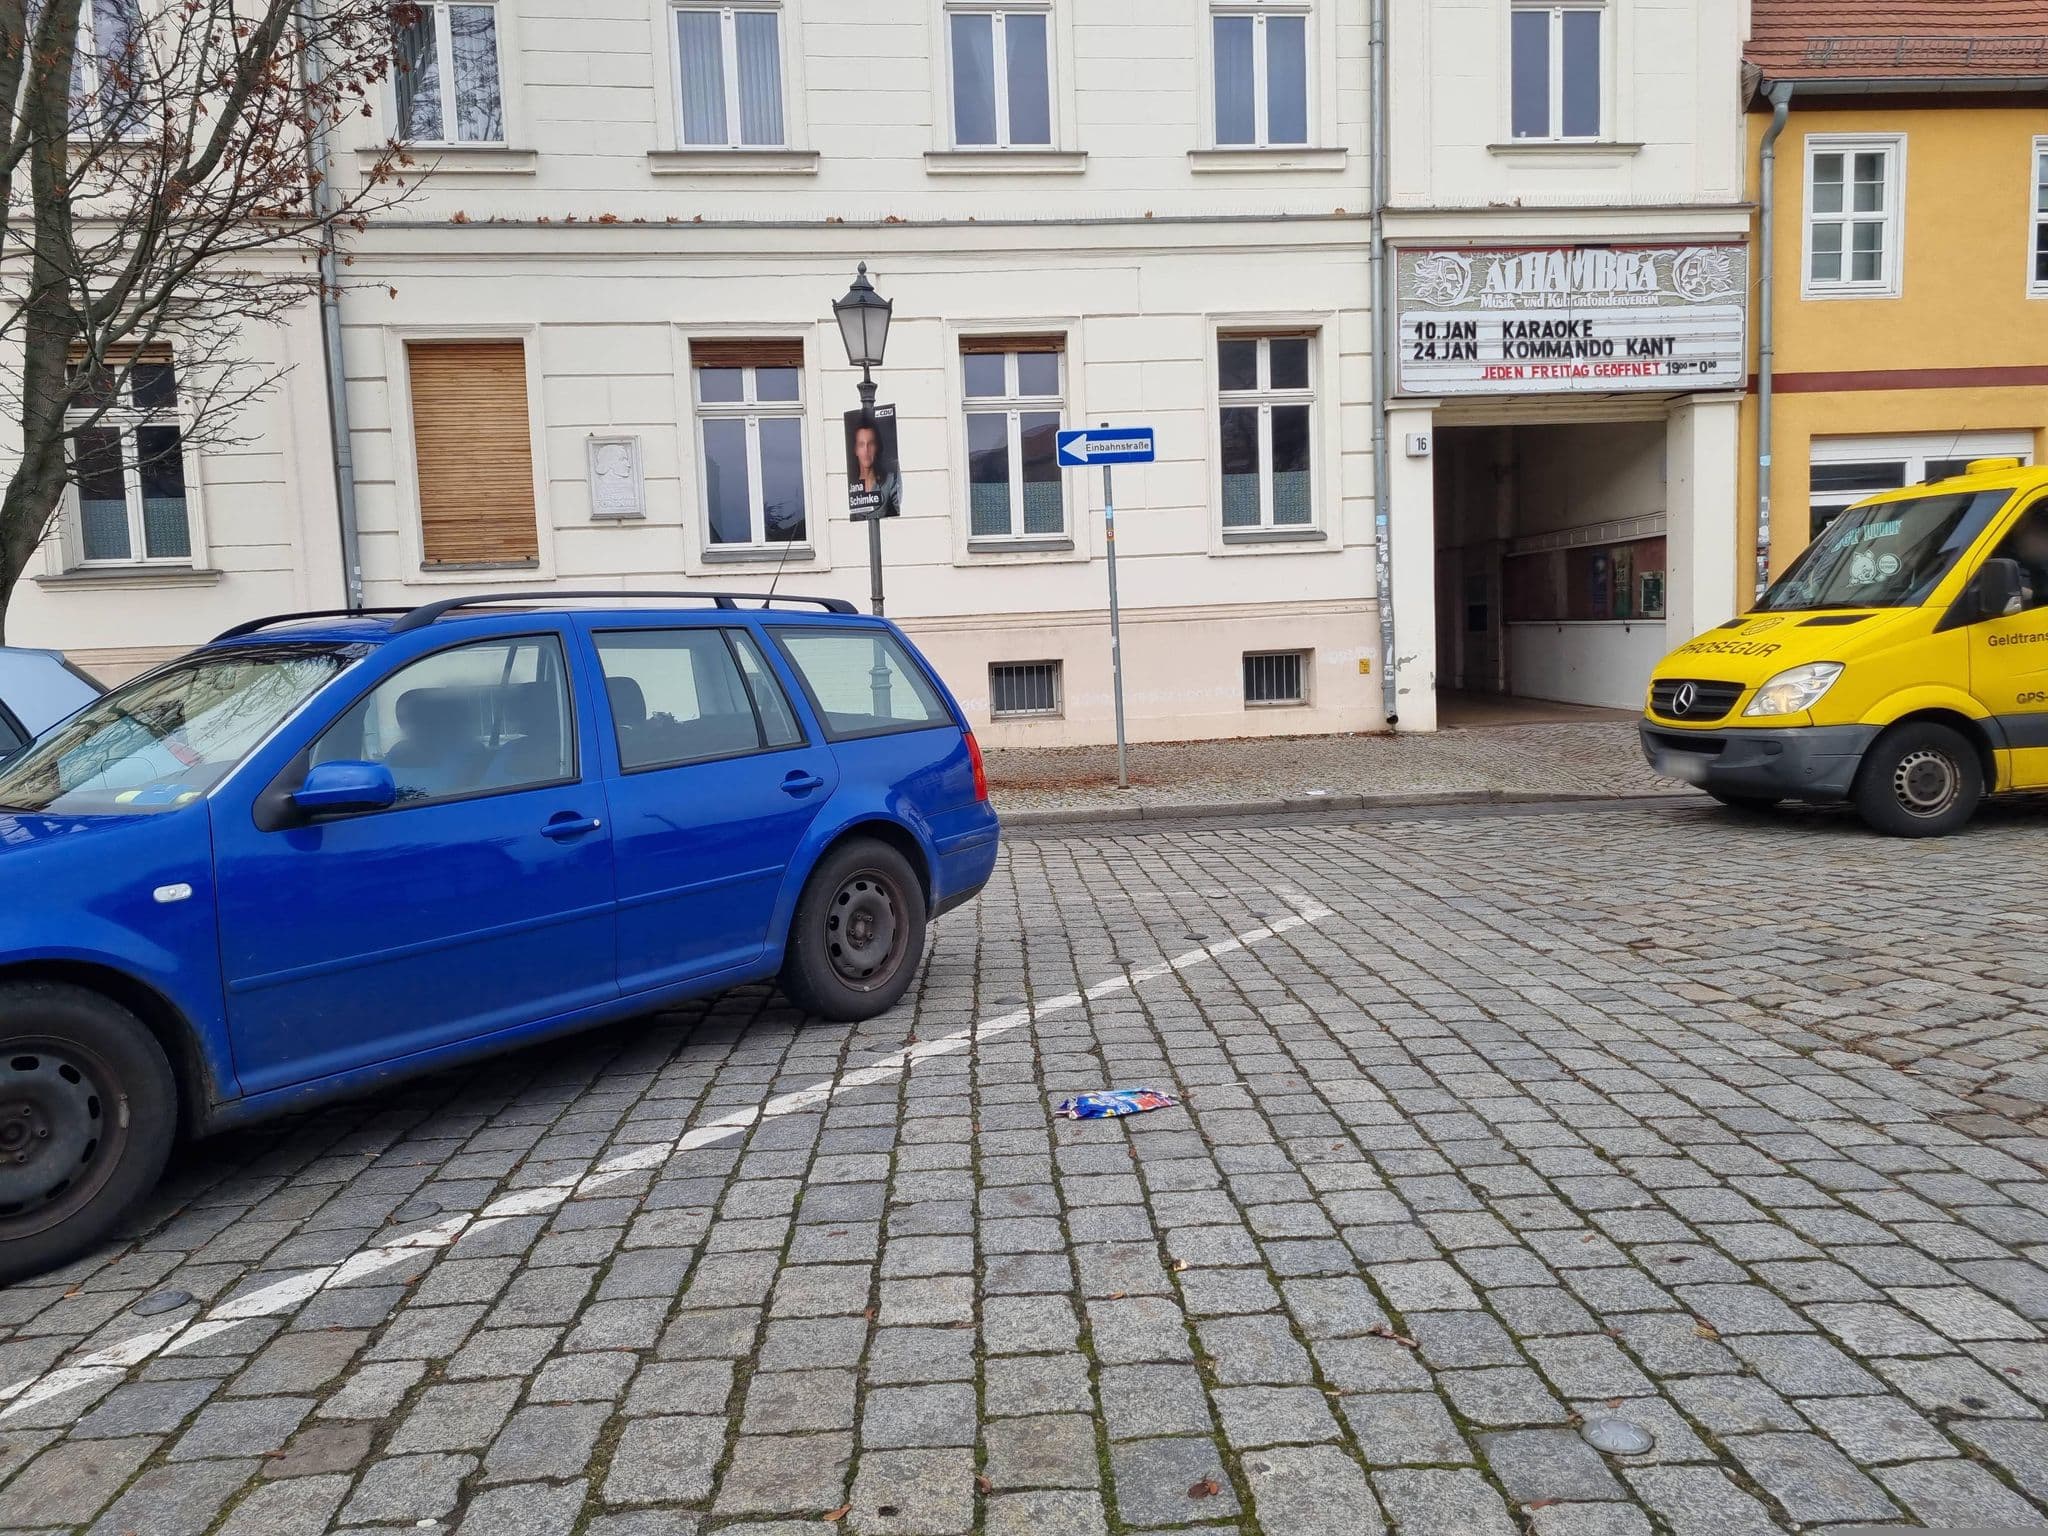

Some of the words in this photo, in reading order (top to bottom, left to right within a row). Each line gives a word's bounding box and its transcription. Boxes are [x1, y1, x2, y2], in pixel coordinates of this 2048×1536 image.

[1480, 249, 1662, 293] ALHAMBRA
[1414, 321, 1477, 340] 10.JAN
[1502, 320, 1593, 340] KARAOKE
[1414, 341, 1478, 360] 24.JAN
[1502, 339, 1614, 359] KOMMANDO
[1626, 337, 1676, 358] KANT
[1481, 366, 1524, 379] JEDEN
[1531, 364, 1590, 379] FREITAG
[1593, 361, 1661, 377] GEÖFFNET
[880, 408, 893, 416] CDU
[1085, 441, 1149, 452] Einbahnstraße
[1416, 437, 1427, 451] 16
[850, 483, 864, 492] Jana
[850, 494, 879, 506] Schimke
[1672, 641, 1782, 658] PROSEGUR
